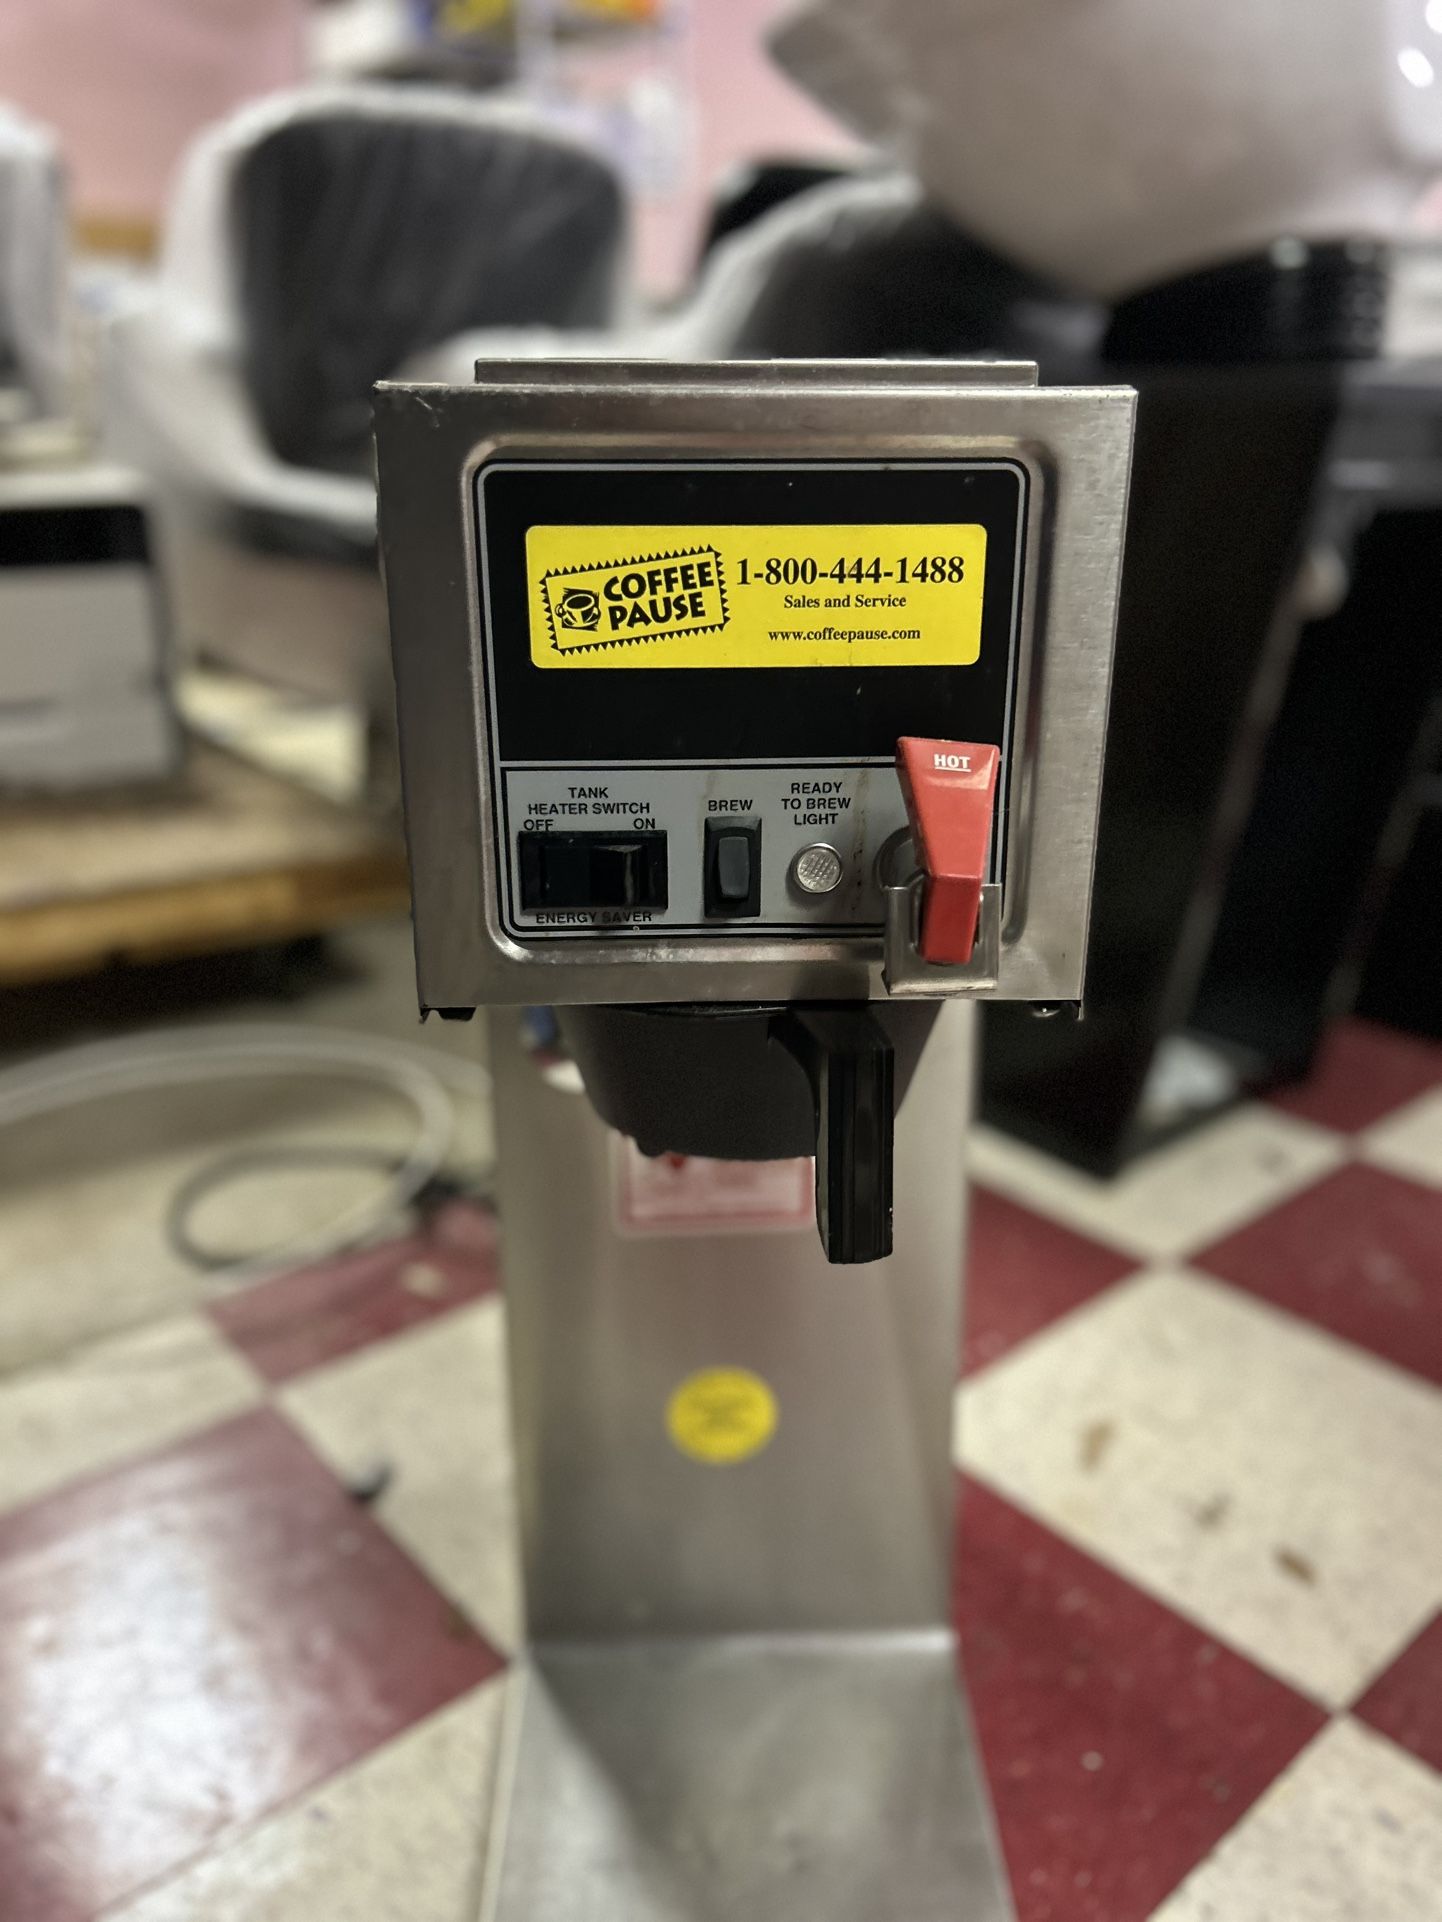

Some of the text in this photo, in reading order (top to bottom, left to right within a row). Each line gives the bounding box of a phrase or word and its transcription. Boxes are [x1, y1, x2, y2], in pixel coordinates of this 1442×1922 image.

[737, 556, 965, 585] 1-800-444-1488
[603, 561, 714, 601] COFFEE
[783, 594, 907, 608] Sales and Service
[608, 591, 706, 631] PAUSE
[768, 627, 921, 643] www.coffeepause.com
[934, 753, 971, 769] HOT
[568, 787, 609, 799] TANK
[791, 782, 843, 794] READY
[528, 802, 650, 815] HEATER SWITCH
[708, 799, 753, 811] BREW
[781, 797, 851, 810] TO BREW
[523, 818, 656, 831] OFF ON
[794, 813, 839, 825] LIGHT
[536, 911, 653, 924] ENERGY SAVER
